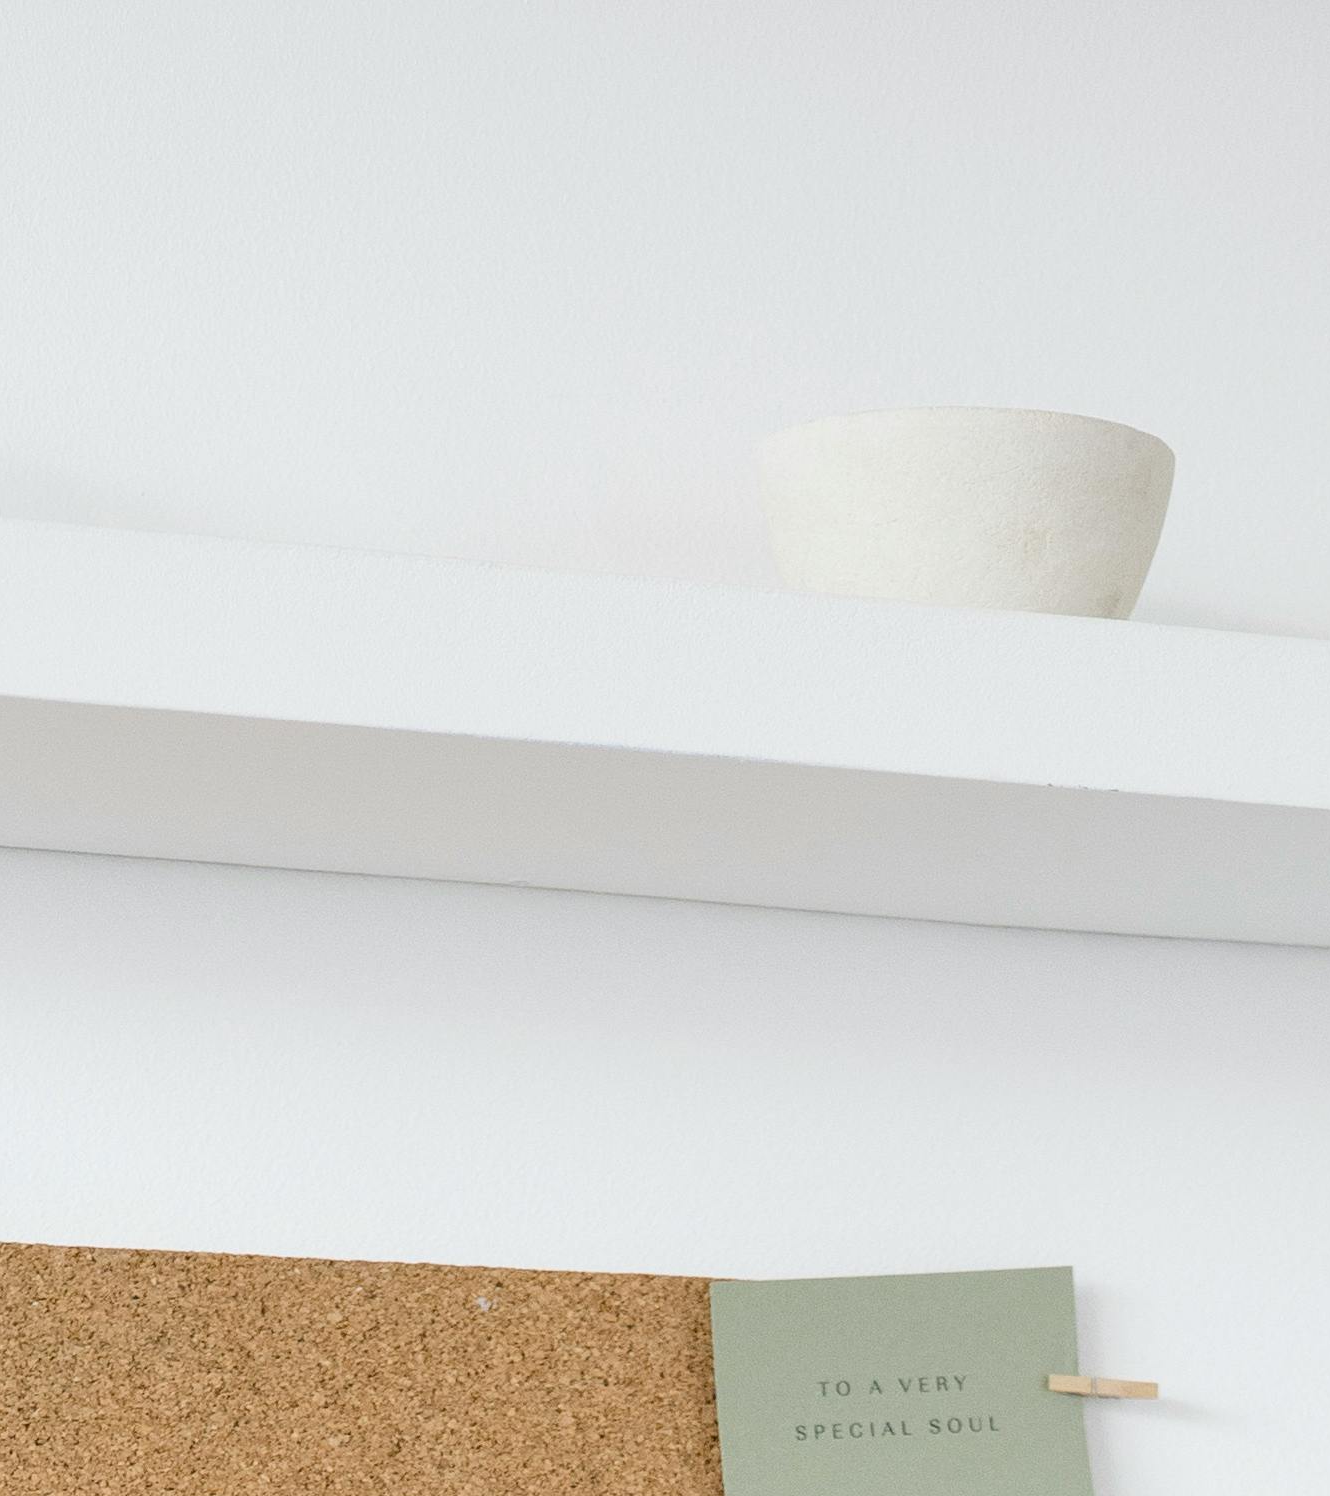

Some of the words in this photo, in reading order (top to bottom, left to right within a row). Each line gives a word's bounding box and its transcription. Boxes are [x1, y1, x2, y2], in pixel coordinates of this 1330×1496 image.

[816, 1379, 853, 1398] TO
[868, 1379, 884, 1395] A
[897, 1374, 969, 1394] VERY
[794, 1420, 913, 1442] SPECIAL
[928, 1415, 1001, 1436] SOUL
